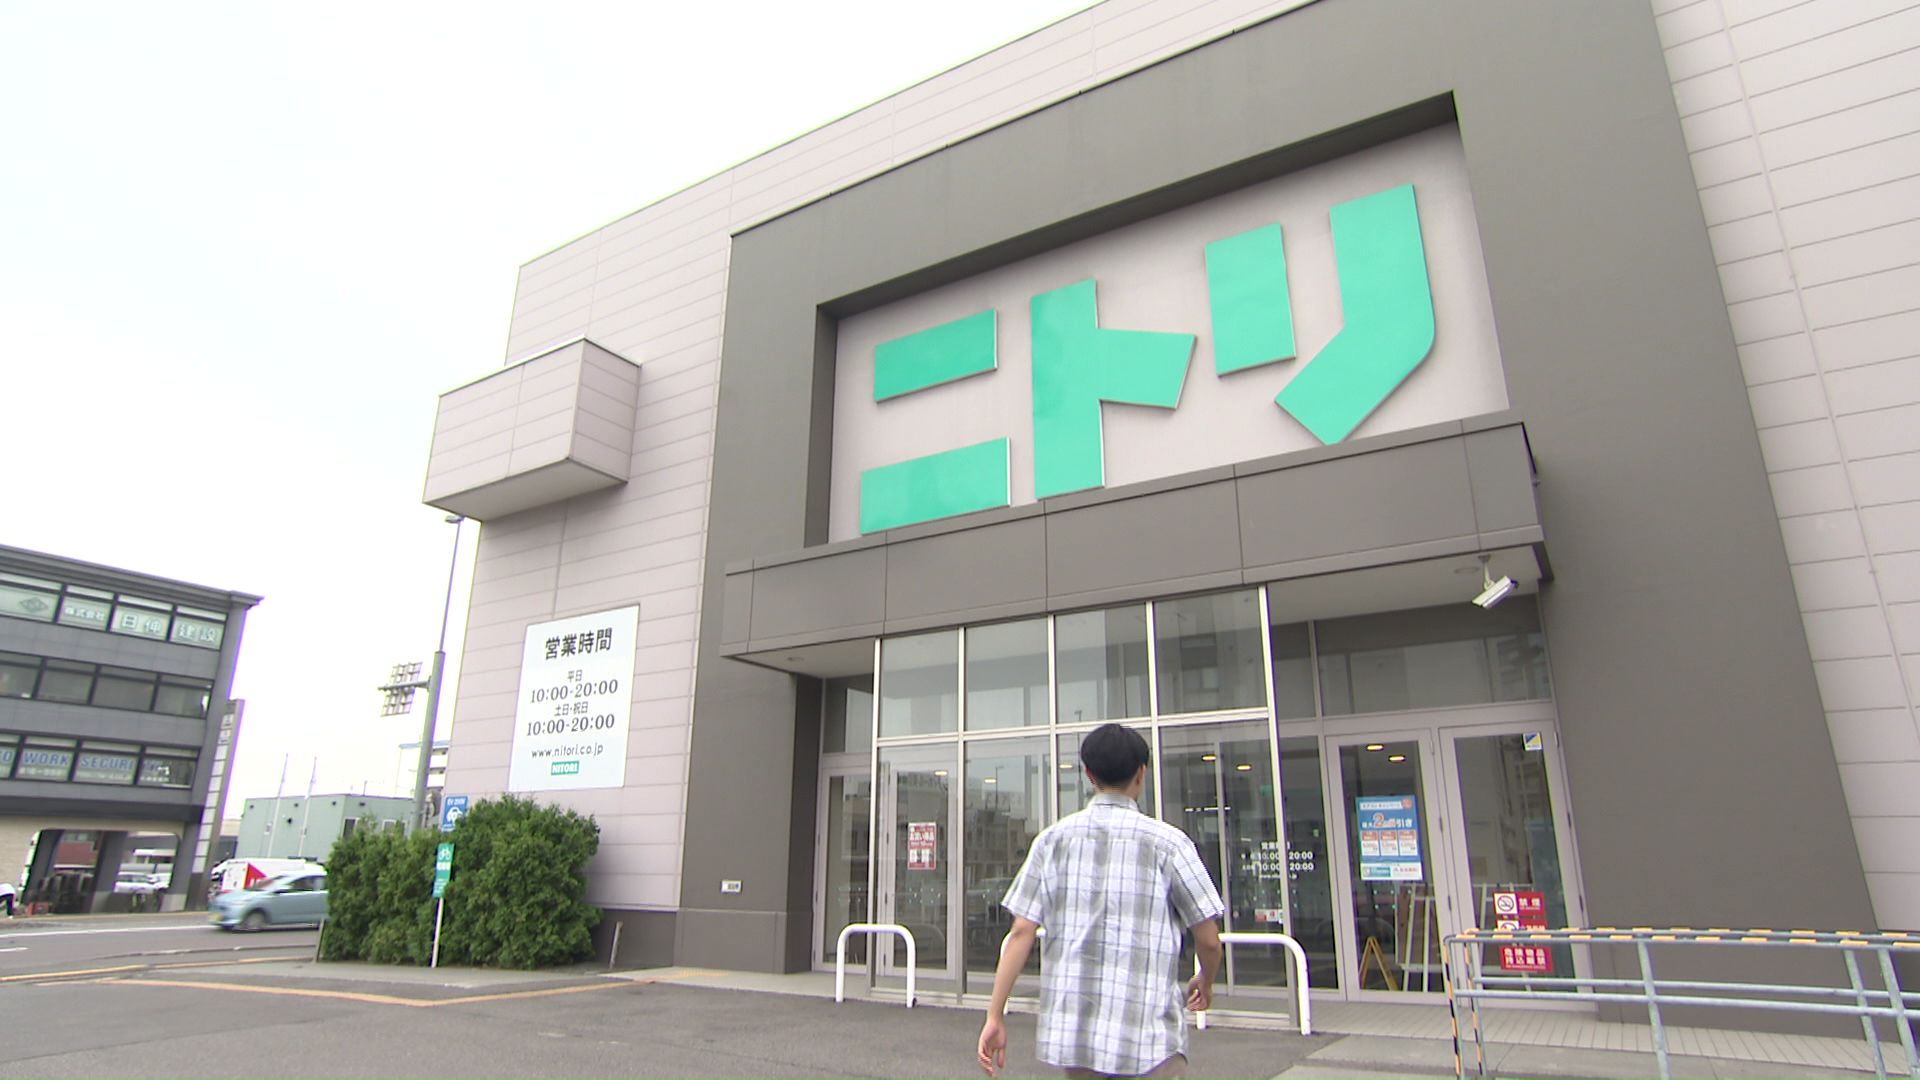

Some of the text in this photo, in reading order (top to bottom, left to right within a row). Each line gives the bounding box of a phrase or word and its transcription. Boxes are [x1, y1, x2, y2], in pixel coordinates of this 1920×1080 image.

[860, 183, 1436, 537] ニトリ
[545, 627, 613, 660] 営業時間
[567, 669, 583, 683] 平日
[530, 679, 618, 704] 10:00-20:00
[554, 701, 589, 717] 土日・祝日
[527, 714, 615, 736] 10:00-20:00
[531, 742, 604, 759] www.nitori.co.jp
[24, 752, 70, 767] WORK
[551, 762, 579, 774] NITORI
